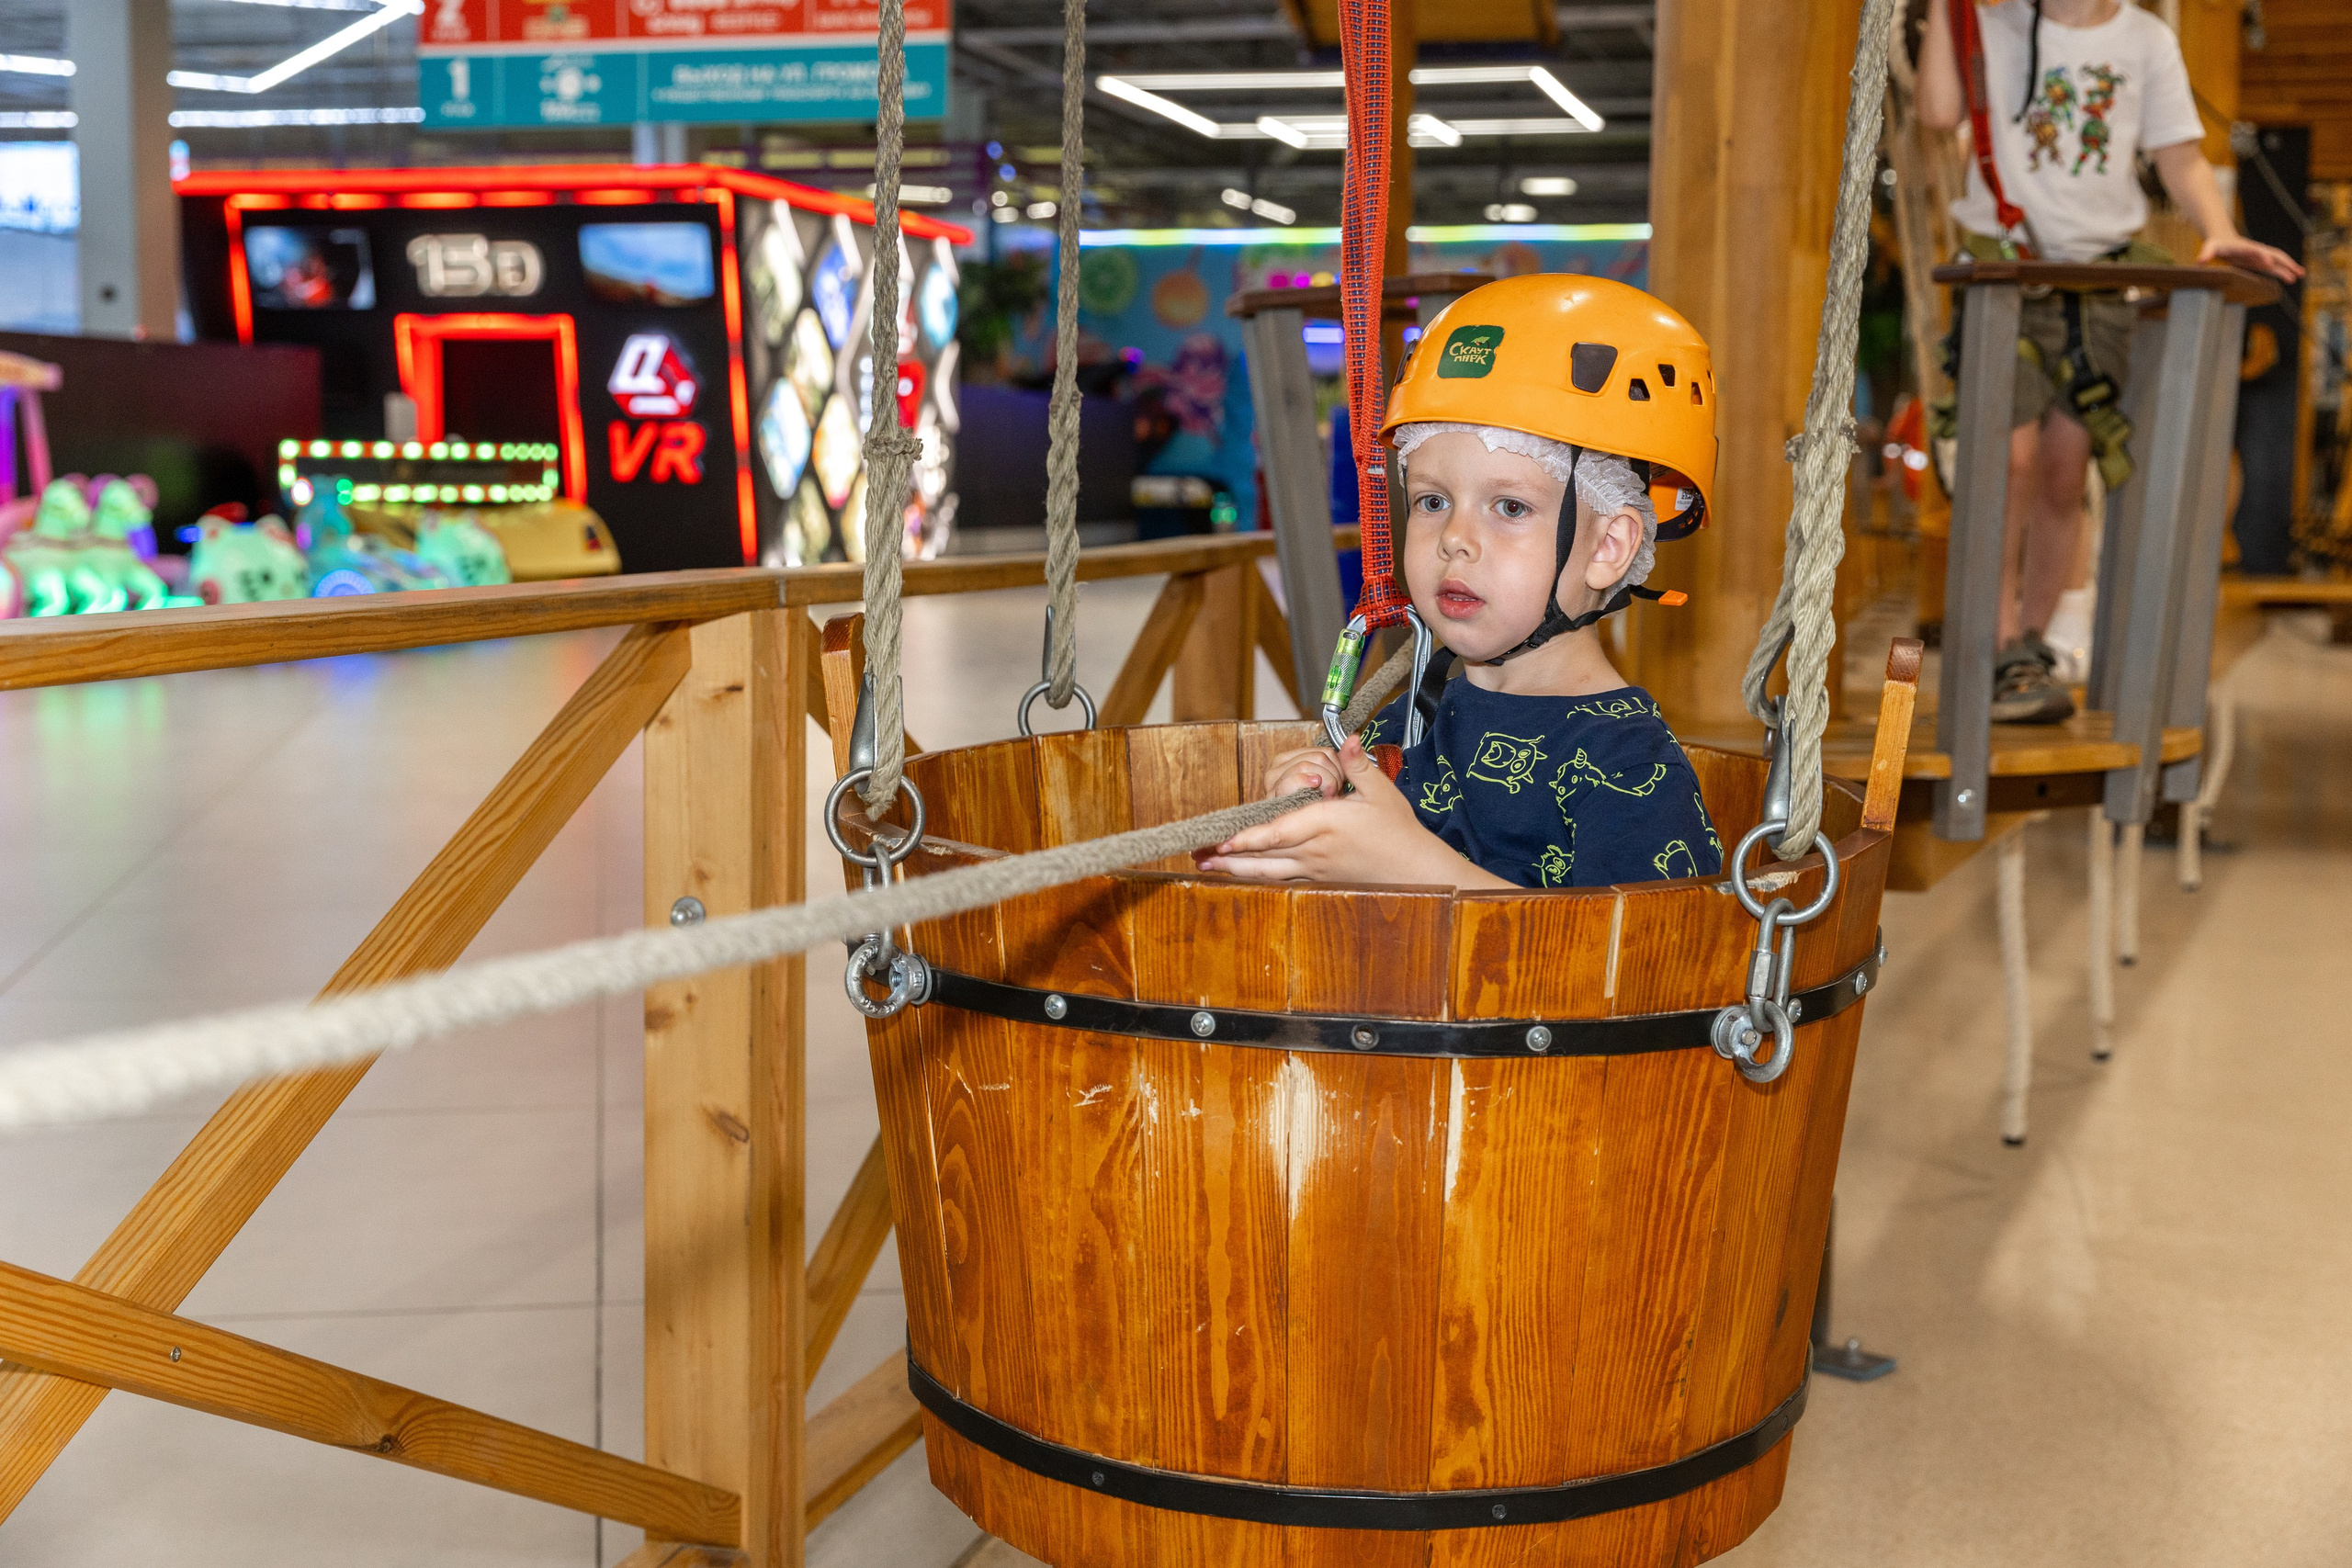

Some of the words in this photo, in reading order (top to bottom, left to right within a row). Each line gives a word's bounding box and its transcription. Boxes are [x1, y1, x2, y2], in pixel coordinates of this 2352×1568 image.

[1449, 341, 1492, 356] СКАУТ
[1453, 354, 1487, 366] ПАРК
[607, 419, 707, 484] VR
